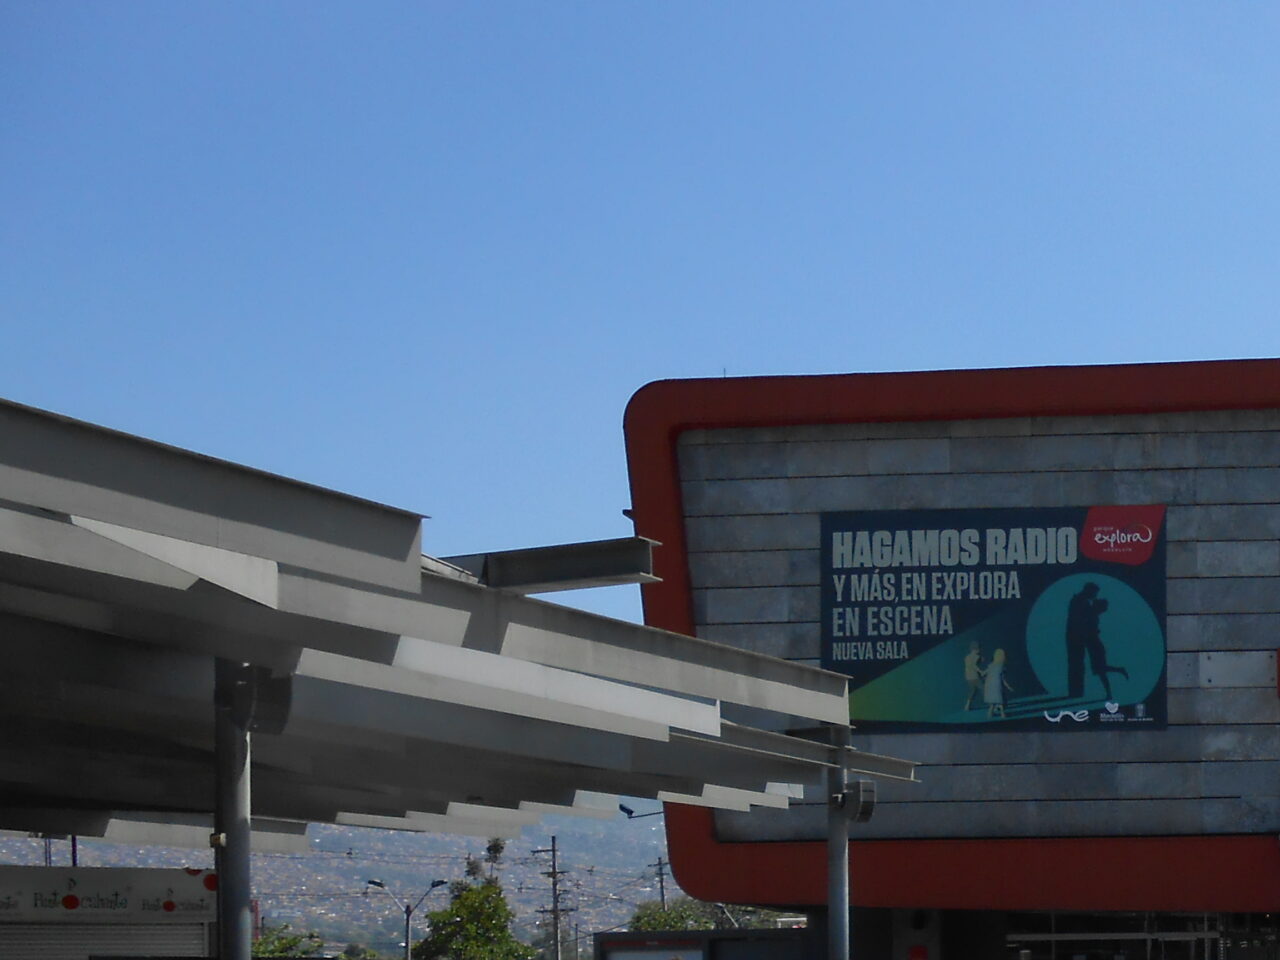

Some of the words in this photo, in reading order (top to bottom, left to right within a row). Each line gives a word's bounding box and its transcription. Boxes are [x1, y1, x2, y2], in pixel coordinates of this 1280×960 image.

[832, 529, 980, 568] HAGAMOS
[986, 527, 1078, 566] RADIO
[1094, 523, 1153, 548] explora
[833, 574, 846, 602] Y
[902, 572, 926, 601] EN
[932, 571, 1021, 600] EXPLORA
[832, 607, 860, 637] EN
[867, 605, 953, 636] ESCENA
[832, 642, 874, 661] NUEVA
[876, 641, 909, 660] SALA
[1044, 709, 1090, 723] une
